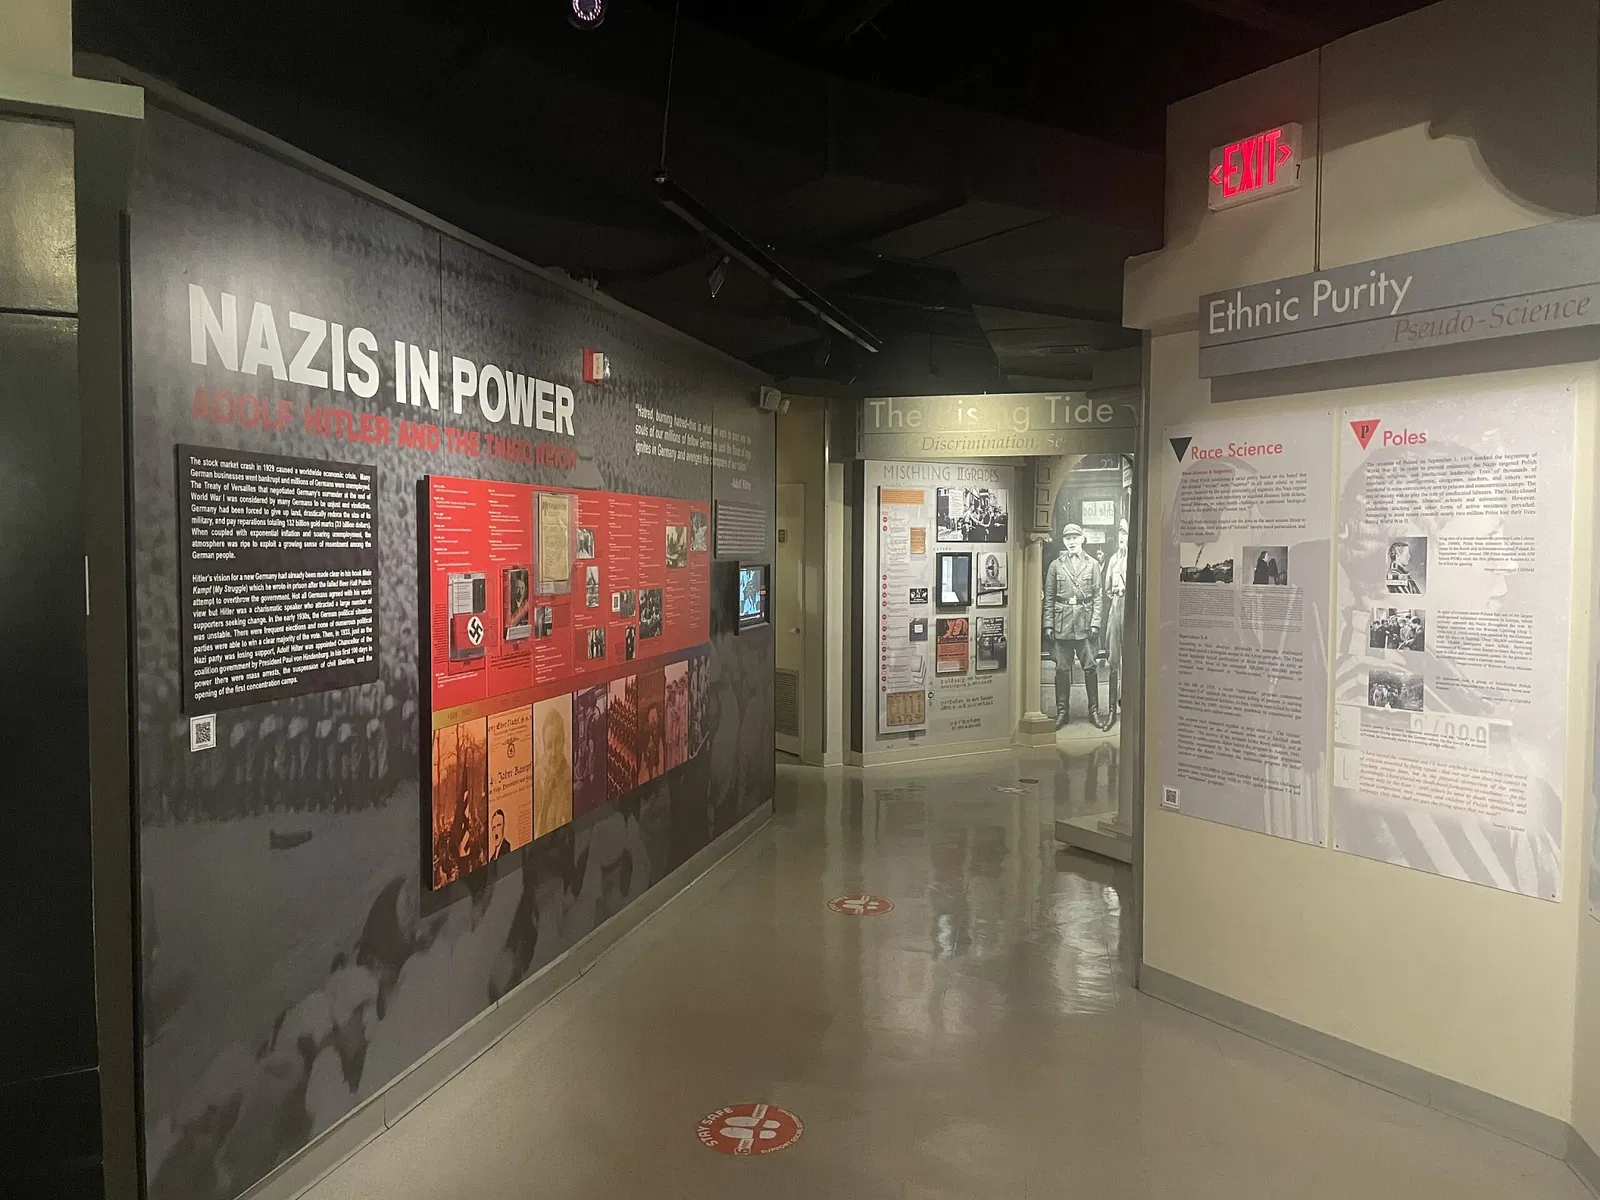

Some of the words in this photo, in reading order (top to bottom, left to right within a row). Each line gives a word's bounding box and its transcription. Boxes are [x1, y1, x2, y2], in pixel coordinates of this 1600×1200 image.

[1223, 128, 1283, 199] EXIT
[1209, 288, 1299, 334] Ethnic
[1312, 269, 1413, 317] Purity
[1393, 297, 1591, 343] Pseudo-Science
[188, 283, 380, 399] NAZIS
[394, 340, 439, 411] IN
[452, 355, 576, 436] POWER
[869, 397, 922, 428] The
[1045, 396, 1114, 424] Tide
[190, 387, 295, 432] ADOLF
[304, 403, 390, 447] HITLER
[397, 420, 441, 451] AND
[445, 427, 481, 457] THE
[483, 433, 532, 463] THIRD
[535, 442, 578, 469] REICH
[1360, 425, 1369, 438] P
[1383, 428, 1427, 446] Poles
[921, 434, 1039, 452] Discrimination,
[1191, 446, 1223, 460] Race
[1228, 441, 1283, 458] Science
[189, 457, 201, 466] The
[202, 458, 218, 467] stock
[219, 460, 239, 469] market
[240, 461, 255, 470] crash
[256, 463, 261, 471] in
[263, 464, 274, 472] 1929
[275, 465, 293, 473] caused
[883, 465, 951, 481] MISCHLING
[190, 469, 213, 478] German
[213, 471, 244, 480] businesses
[244, 473, 257, 481] went
[257, 474, 280, 485] bankrupt
[190, 481, 201, 489] The
[204, 482, 221, 492] Treaty
[223, 483, 229, 491] of
[231, 483, 256, 492] Versailles
[257, 485, 268, 493] that
[190, 492, 208, 501] World
[209, 493, 221, 502] War
[239, 495, 268, 504] considered
[190, 504, 217, 514] Germany
[218, 505, 229, 513] had
[230, 506, 244, 514] been
[270, 508, 281, 516] give
[191, 516, 214, 526] military,
[214, 517, 225, 525] and
[237, 517, 266, 527] reparations
[191, 528, 208, 536] When
[210, 528, 233, 537] coupled
[249, 529, 278, 538] exponential
[191, 539, 225, 549] atmosphere
[239, 540, 250, 548] ripe
[259, 540, 276, 548] exploit
[191, 551, 214, 559] German
[215, 551, 236, 560] people.
[192, 574, 212, 582] Hitler's
[213, 573, 230, 581] vision
[192, 585, 212, 595] Kampf
[212, 585, 223, 594] (My
[223, 583, 248, 593] Struggle)
[248, 583, 264, 591] which
[192, 596, 214, 607] attempt
[215, 596, 221, 604] to
[222, 594, 250, 603] overthrow
[250, 594, 259, 602] the
[192, 608, 206, 617] view
[208, 608, 218, 616] but
[219, 606, 234, 615] Hitler
[193, 618, 223, 630] supporters
[225, 617, 246, 627] seeking
[247, 615, 267, 625] change.
[206, 629, 231, 639] unstable.
[233, 627, 248, 636] There
[193, 642, 213, 653] parties
[228, 639, 240, 648] able
[241, 638, 247, 646] to
[193, 654, 206, 663] Nazi
[208, 652, 222, 663] party
[236, 649, 253, 659] losing
[193, 664, 218, 675] coalition
[218, 660, 250, 673] government
[251, 659, 258, 668] by
[194, 678, 212, 688] power
[214, 674, 228, 683] there
[245, 671, 260, 679] mass
[194, 687, 217, 700] opening
[218, 686, 224, 694] of
[224, 685, 234, 693] the
[234, 683, 245, 692] first
[246, 677, 280, 690] concentration
[702, 1107, 734, 1125] SAFE
[697, 1125, 719, 1147] STAY
